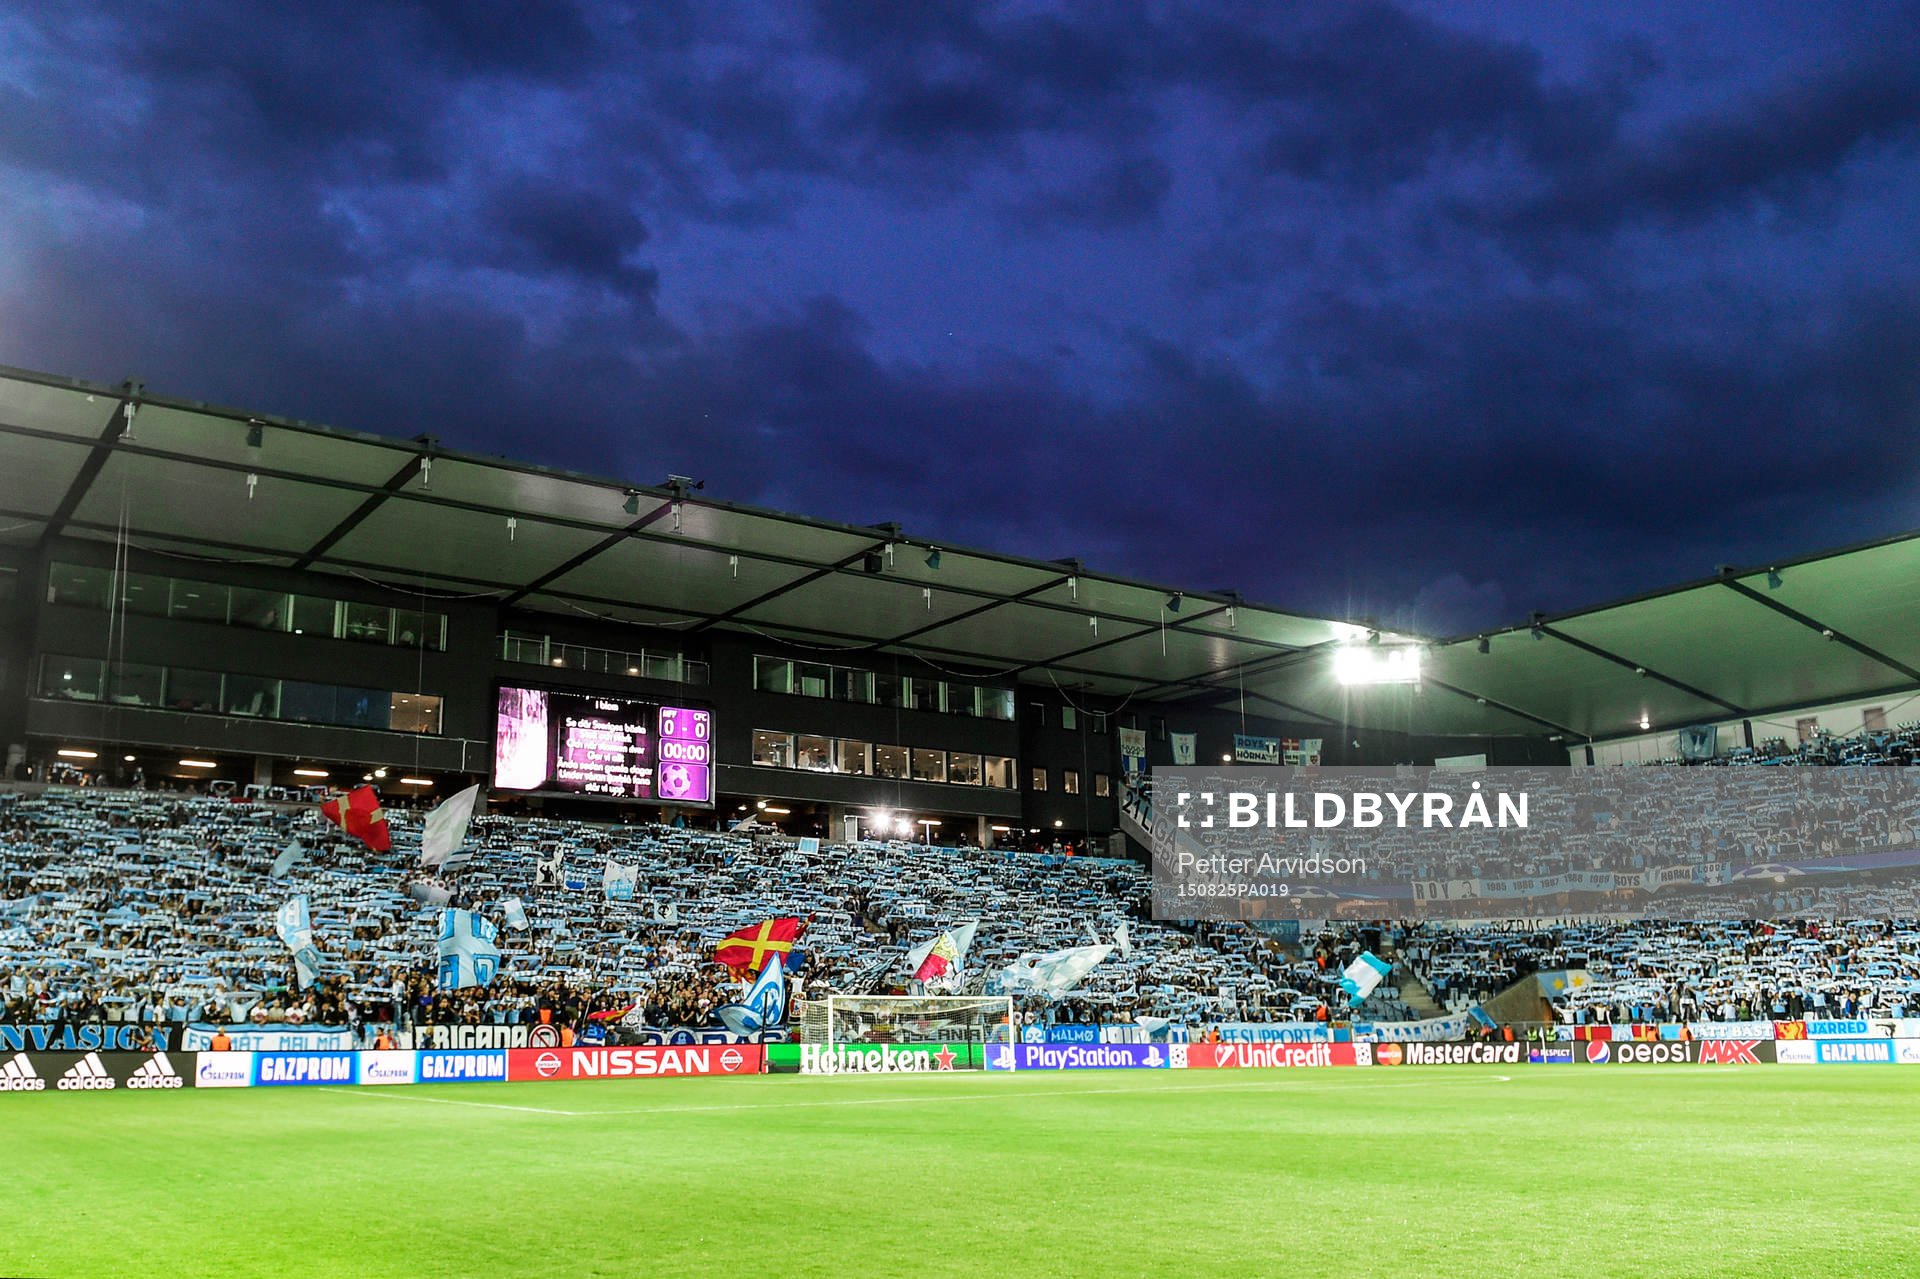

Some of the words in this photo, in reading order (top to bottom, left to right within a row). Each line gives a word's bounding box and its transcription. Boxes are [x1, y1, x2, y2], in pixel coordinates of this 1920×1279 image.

[664, 719, 674, 735] 0
[695, 722, 705, 738] 0
[664, 742, 705, 761] 00:00
[1237, 750, 1266, 760] HÖRNA
[1416, 883, 1449, 899] ROY
[572, 1049, 710, 1077] NISSAN
[799, 1043, 930, 1073] Heineken
[1026, 1045, 1134, 1070] PlayStation
[1238, 1043, 1332, 1068] UniCredit
[1406, 1041, 1520, 1065] MasterCard
[1618, 1041, 1691, 1065] pepsi
[1698, 1040, 1762, 1065] MAX
[1821, 1043, 1889, 1061] GAZPROM
[261, 1056, 350, 1081] GAZPROM
[422, 1054, 504, 1078] GAZPROM
[0, 1076, 45, 1091] didas
[57, 1075, 116, 1091] adidas
[127, 1074, 184, 1089] adidas
